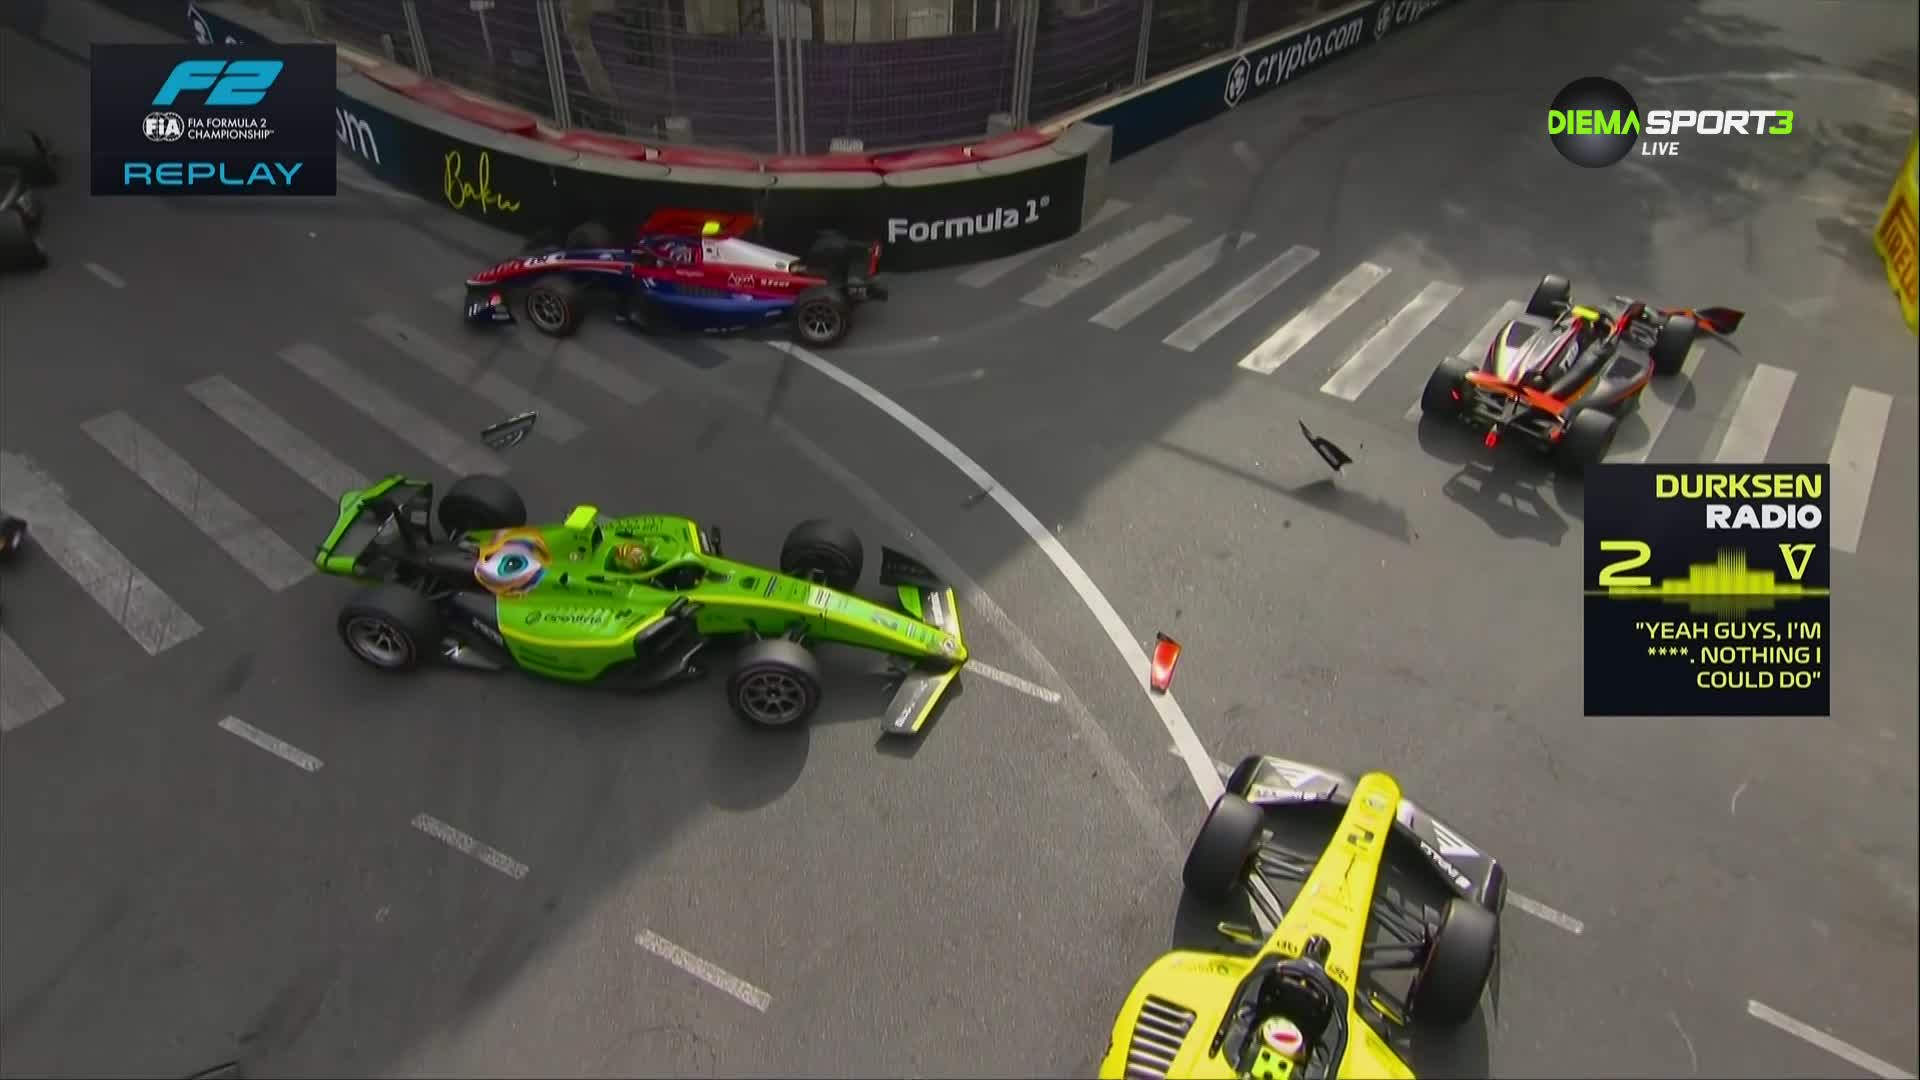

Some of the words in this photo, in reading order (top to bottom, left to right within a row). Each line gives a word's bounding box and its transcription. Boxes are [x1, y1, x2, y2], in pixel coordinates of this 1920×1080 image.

[1254, 19, 1363, 87] crypto.com
[444, 151, 521, 215] Baku
[887, 206, 1020, 244] Formula
